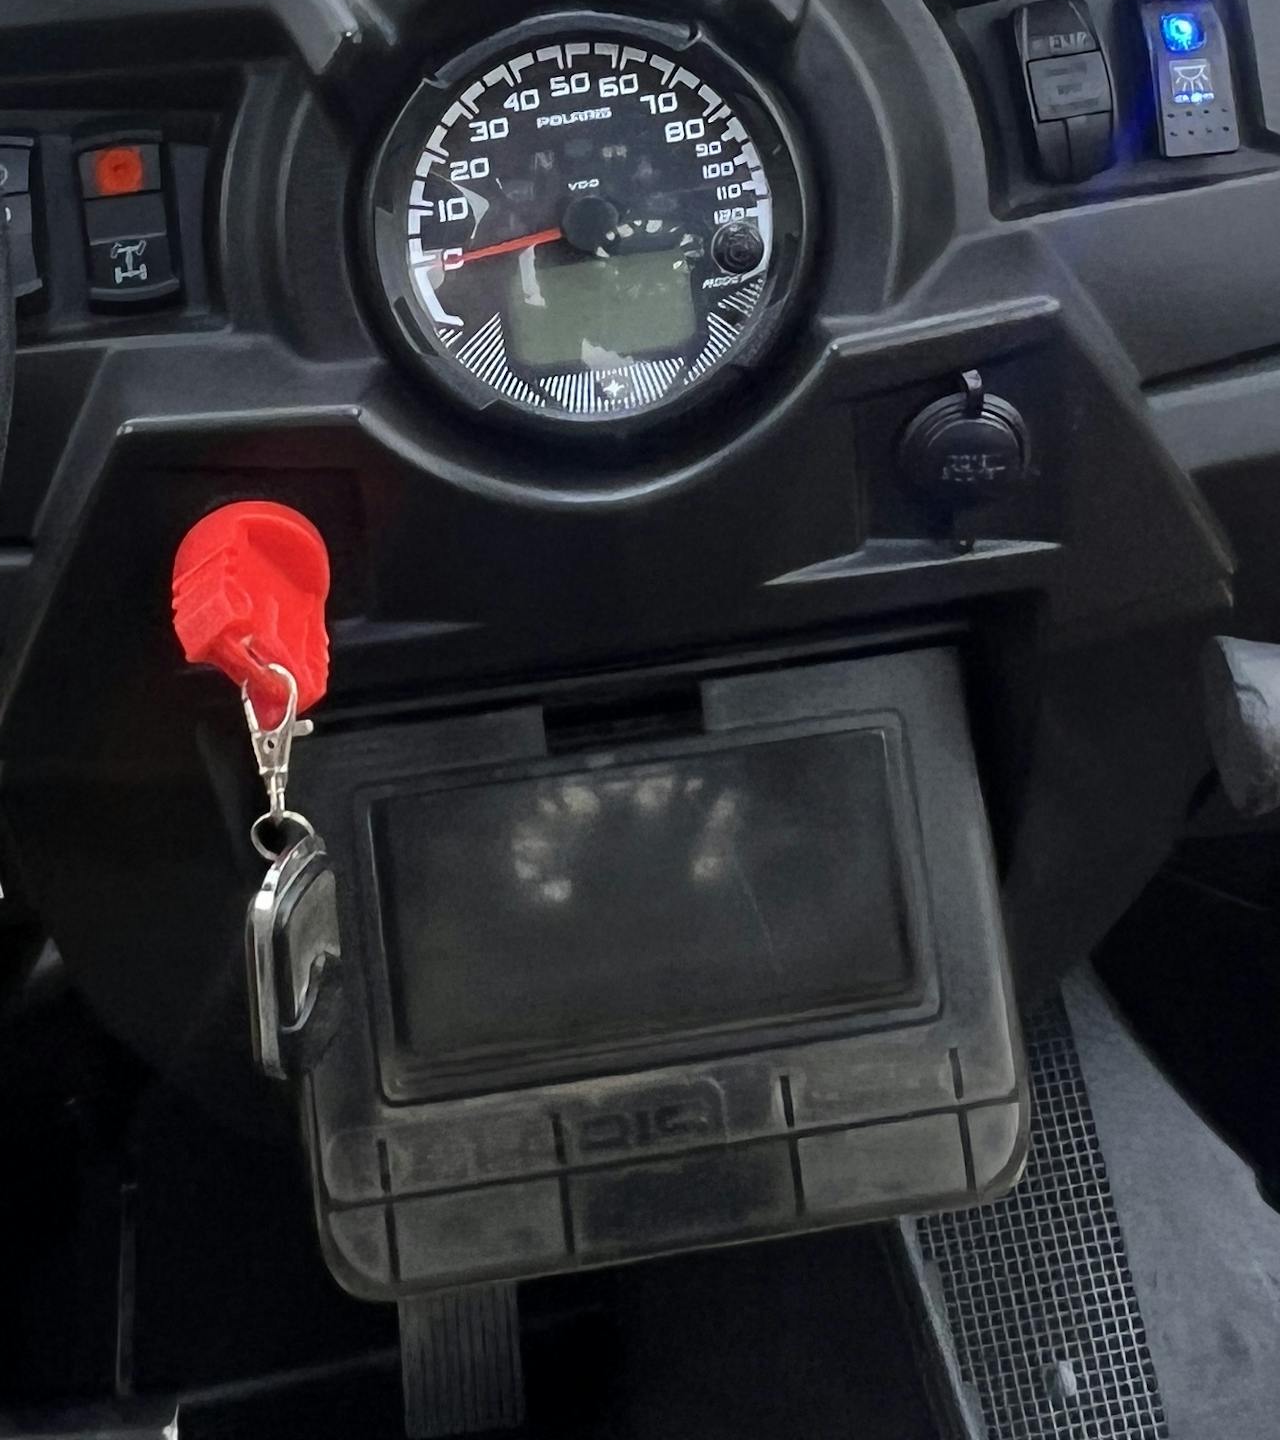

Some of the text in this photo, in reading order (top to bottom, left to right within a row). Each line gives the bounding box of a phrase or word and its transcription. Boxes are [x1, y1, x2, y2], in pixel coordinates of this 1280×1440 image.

[549, 72, 591, 98] 50
[598, 73, 639, 97] 60
[503, 88, 540, 112] 40
[640, 92, 678, 115] 70
[469, 117, 510, 142] 30
[536, 106, 612, 129] POLARIS
[665, 118, 705, 143] 80
[695, 141, 722, 158] 90
[450, 157, 490, 181] 20
[702, 161, 735, 179] 100
[567, 178, 600, 191] VDO
[716, 183, 742, 200] 110
[438, 197, 469, 222] 10
